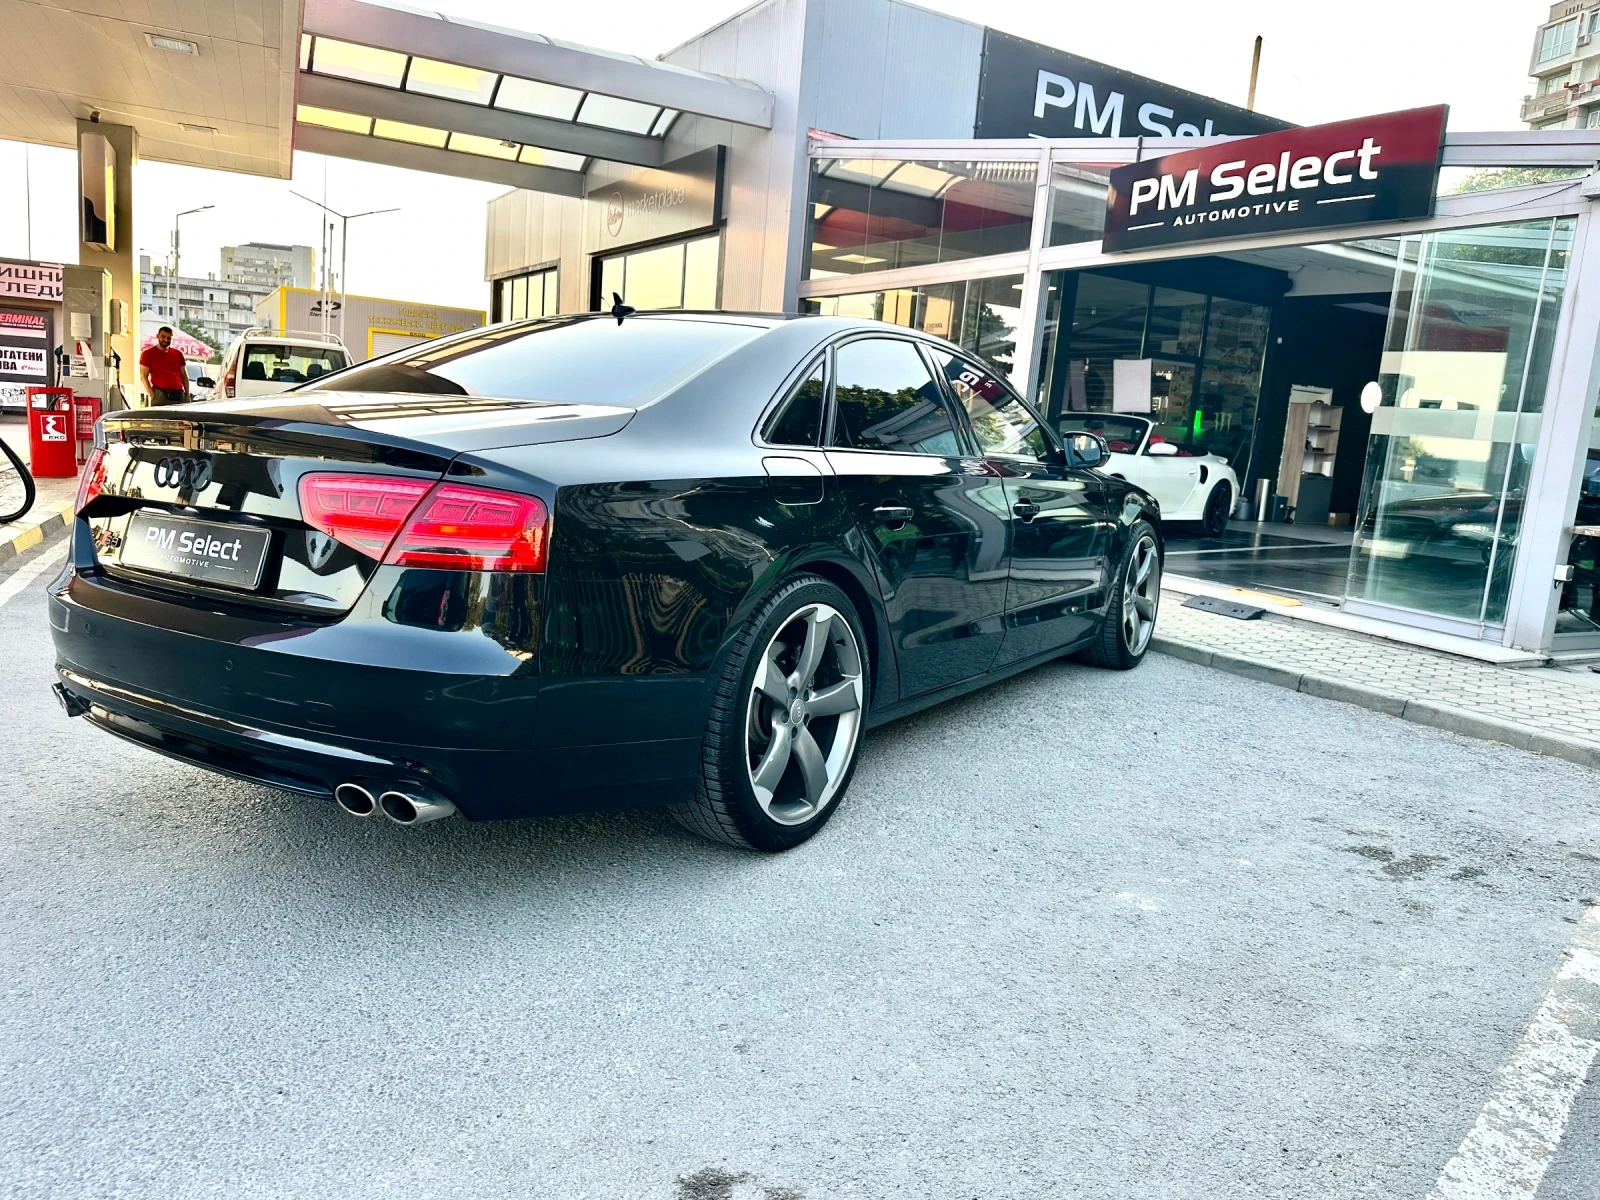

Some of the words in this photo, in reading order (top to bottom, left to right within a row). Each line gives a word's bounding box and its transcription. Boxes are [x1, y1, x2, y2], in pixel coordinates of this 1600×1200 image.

[1033, 69, 1125, 138] PM
[1129, 168, 1200, 216] PM
[1209, 137, 1382, 203] Select
[626, 185, 685, 219] marketplace
[1173, 199, 1300, 227] AUTOMOTIVE
[144, 526, 177, 550] PM
[177, 531, 242, 562] Select
[159, 553, 210, 568] AUTOMOTIVE
